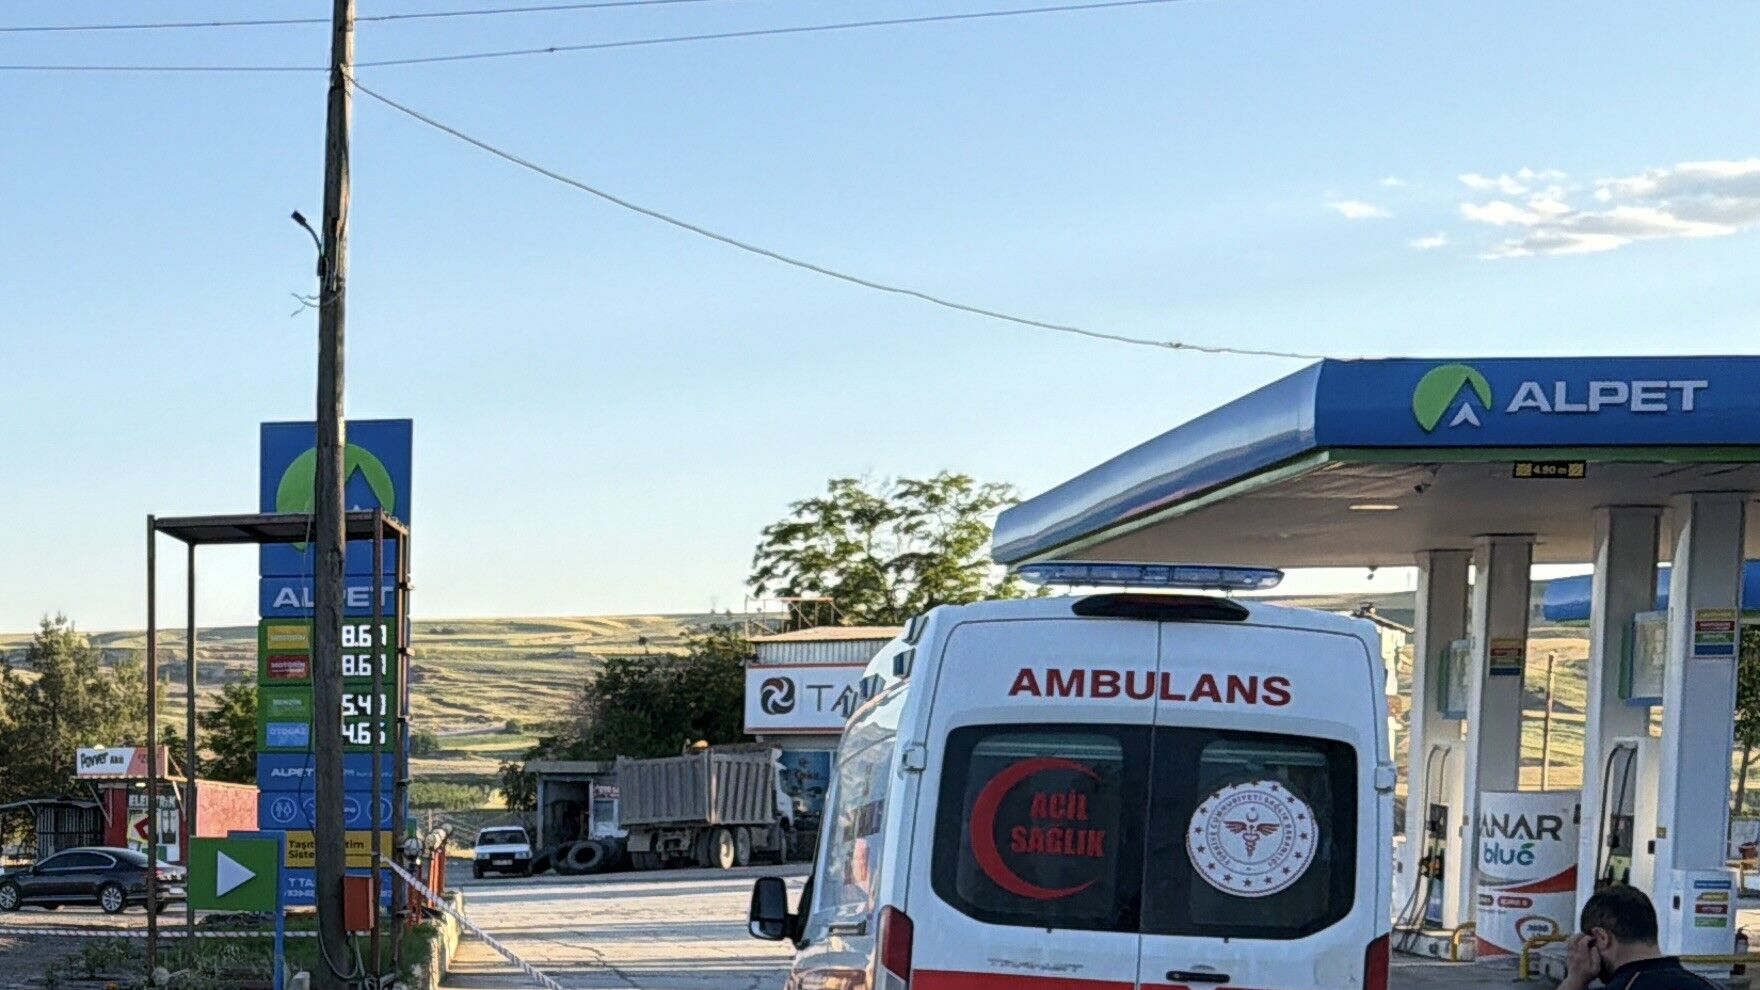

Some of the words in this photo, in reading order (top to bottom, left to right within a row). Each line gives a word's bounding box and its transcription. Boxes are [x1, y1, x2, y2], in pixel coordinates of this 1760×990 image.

[1505, 380, 1709, 412] ALPET
[273, 586, 394, 608] ALET
[1008, 668, 1292, 706] AMBULANS
[1030, 789, 1089, 821] ACİL
[1010, 824, 1105, 858] SAĞLIK
